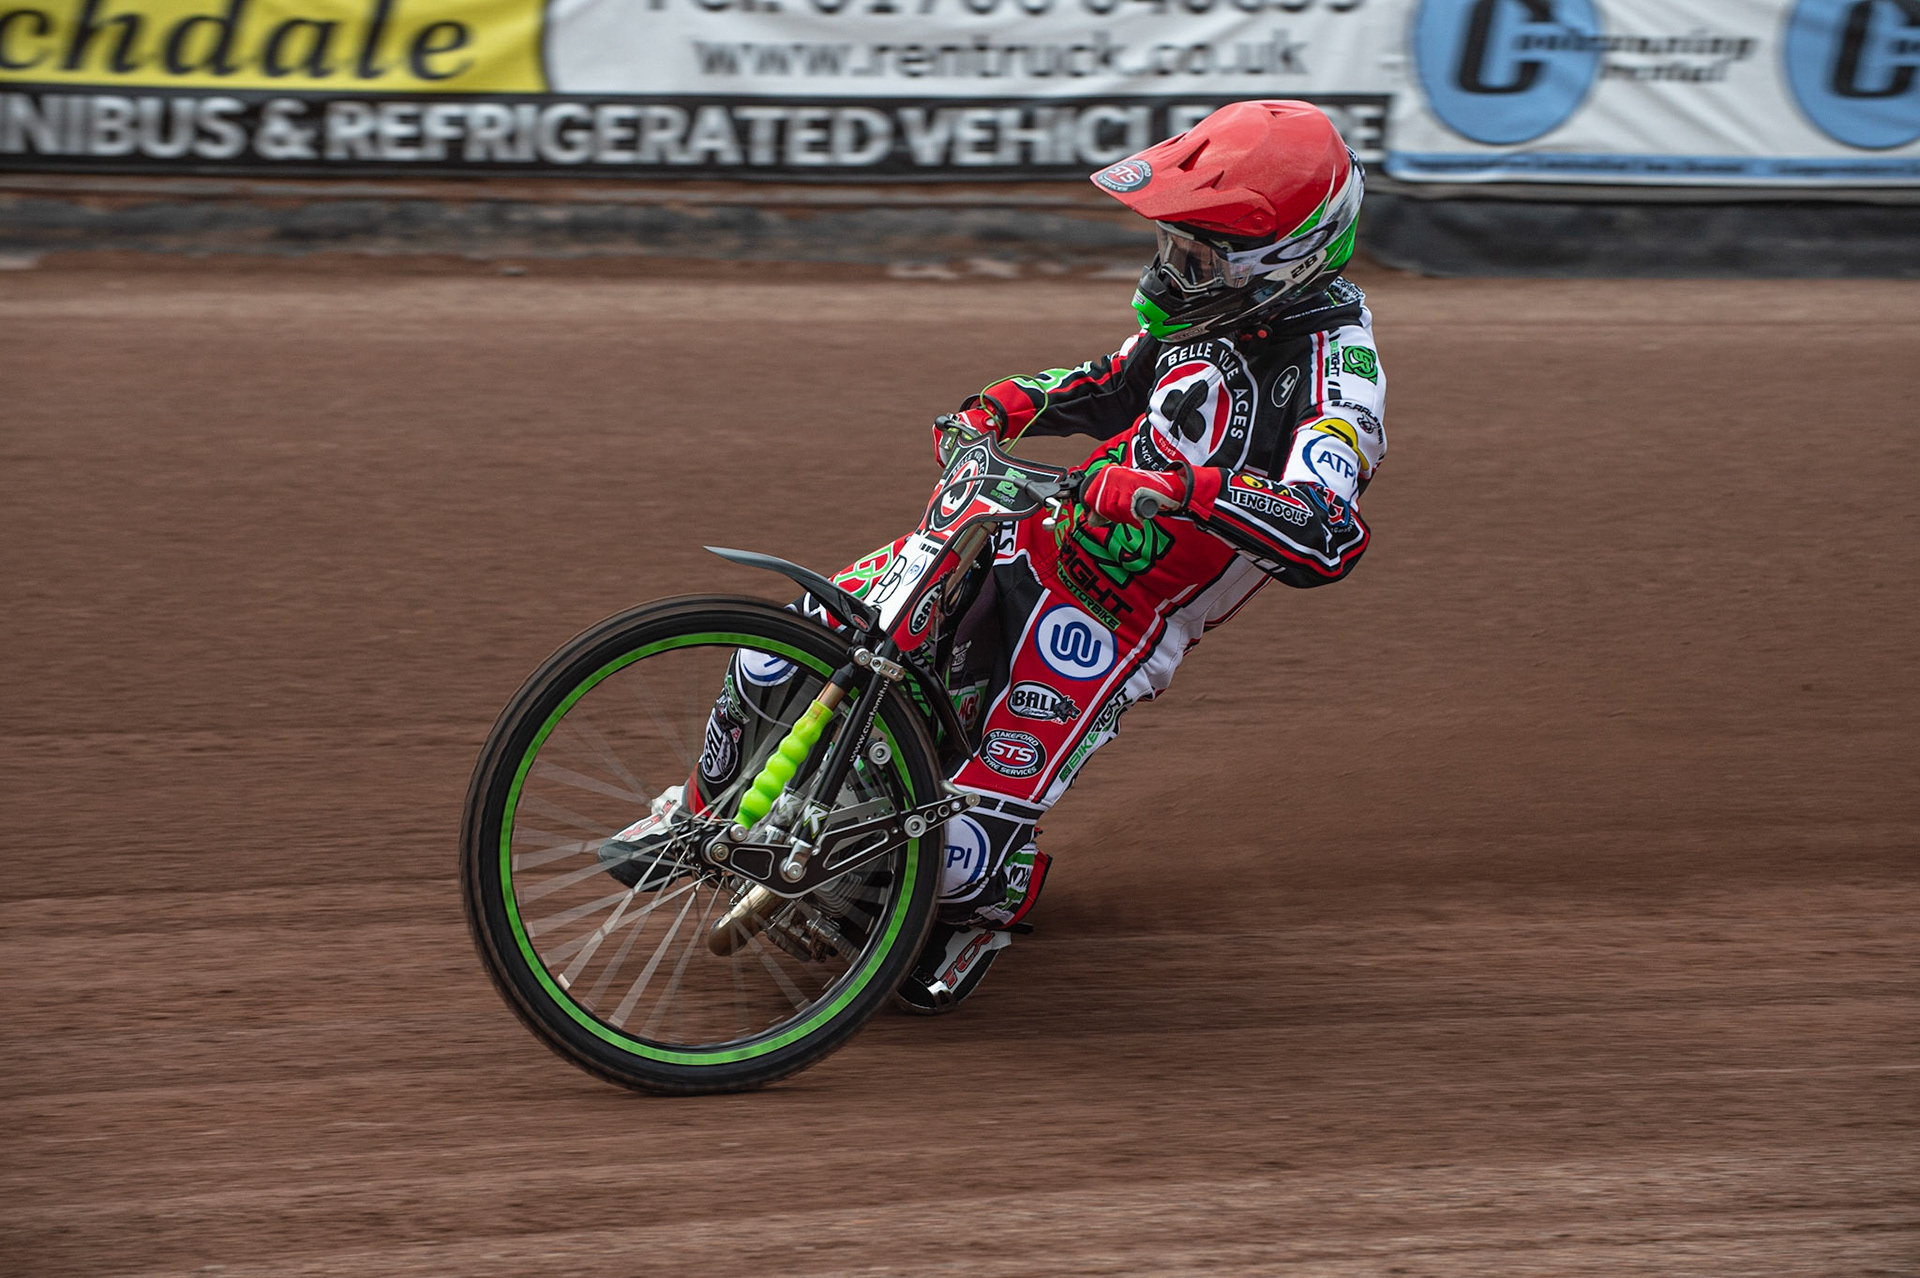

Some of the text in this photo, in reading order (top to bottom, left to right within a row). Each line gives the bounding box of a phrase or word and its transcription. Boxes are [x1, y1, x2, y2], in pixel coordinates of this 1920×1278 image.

[254, 100, 319, 161] &
[326, 102, 895, 165] REFRIGERATED
[1167, 342, 1213, 367] BELLE
[1218, 349, 1239, 381] VUE
[1230, 388, 1249, 439] ACES
[1058, 569, 1120, 630] MOTORBIKE
[989, 731, 1039, 747] STAKEFORD
[989, 741, 1035, 762] STS
[1068, 687, 1127, 769] BIKERIGHT
[983, 755, 1037, 776] TYRE SERVICES
